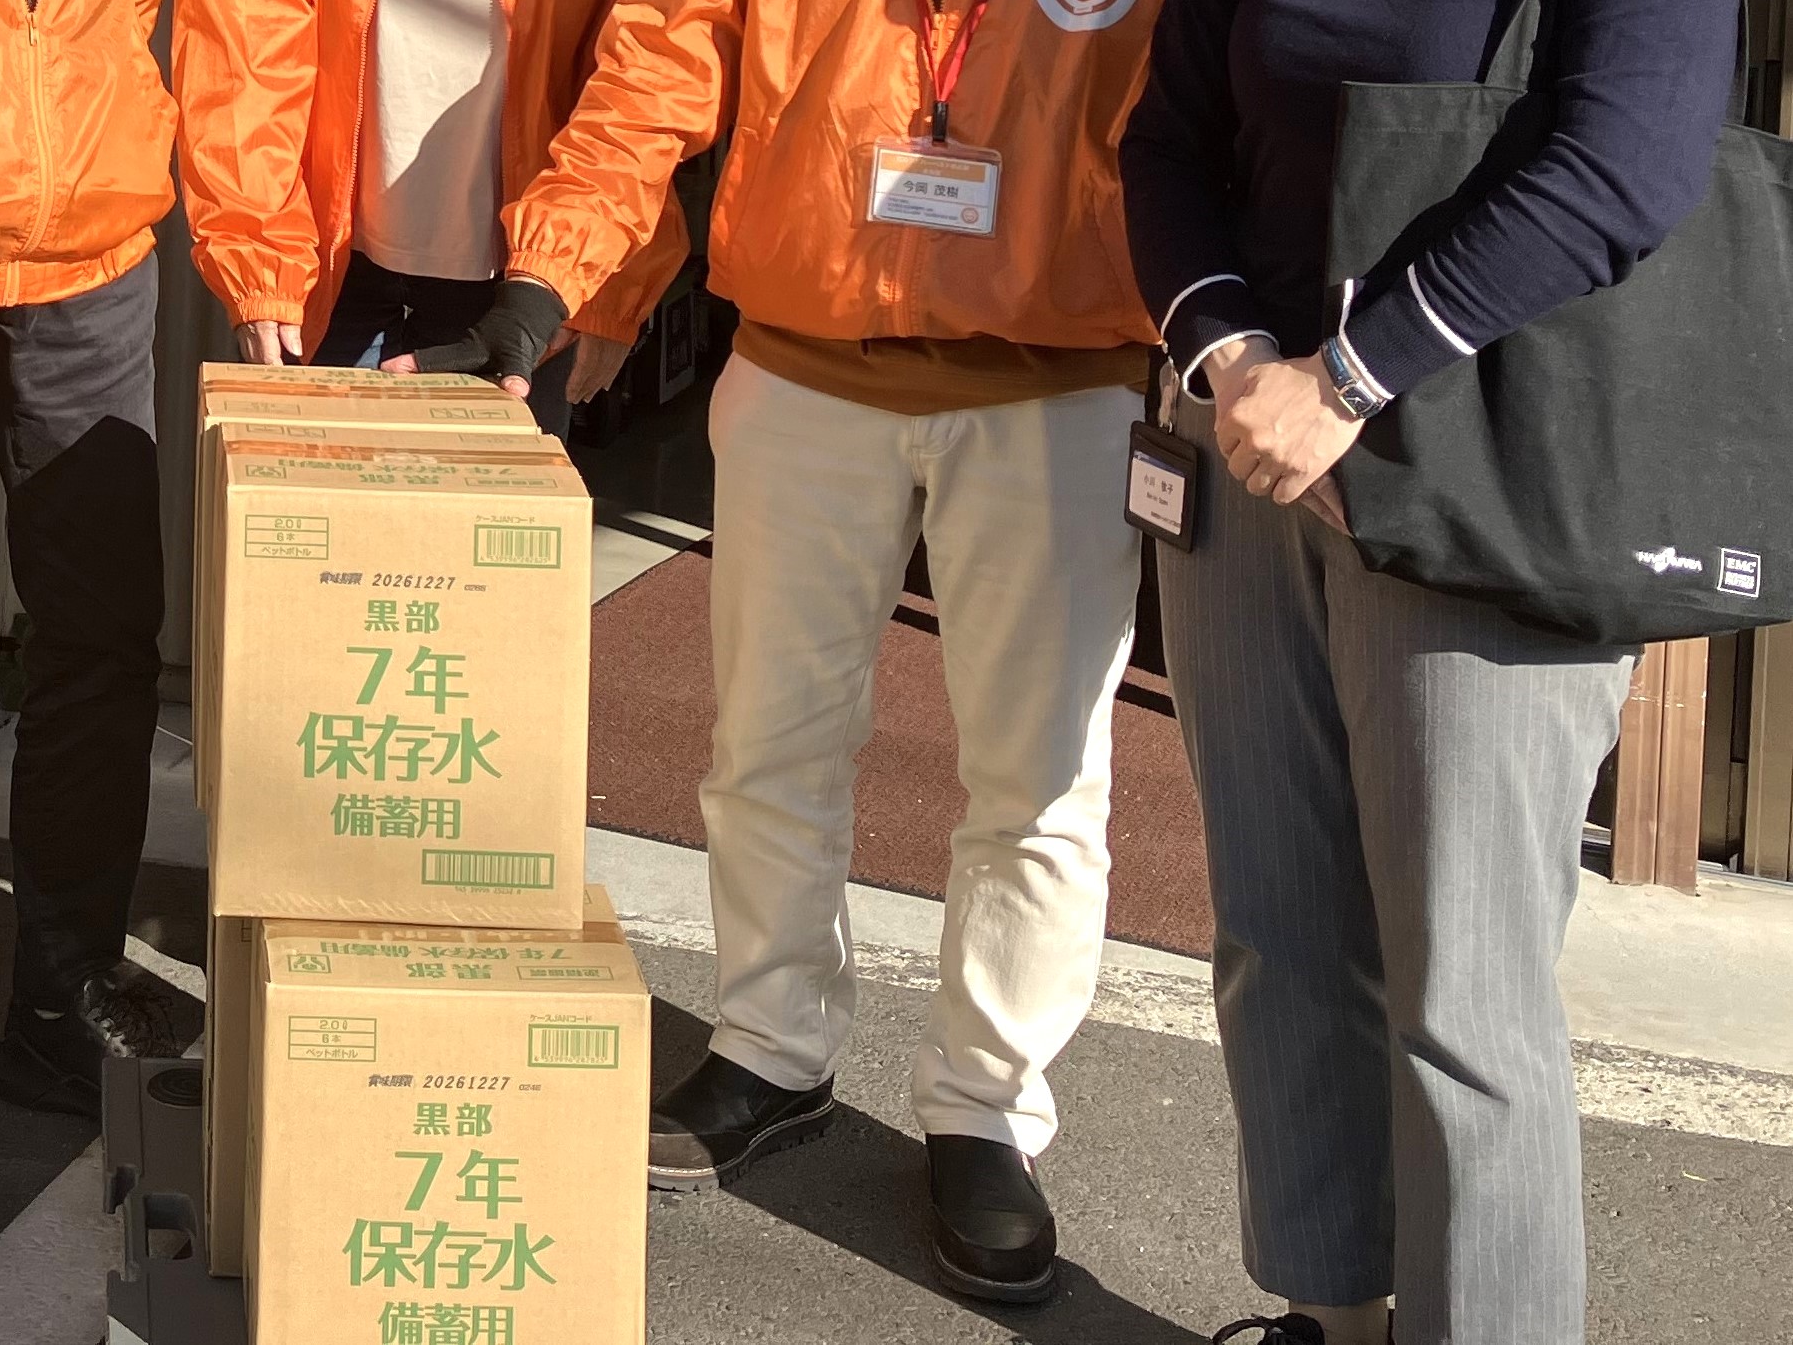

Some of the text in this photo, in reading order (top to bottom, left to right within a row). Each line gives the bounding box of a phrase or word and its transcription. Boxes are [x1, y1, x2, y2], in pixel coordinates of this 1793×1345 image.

[372, 573, 456, 590] 20261227
[1726, 558, 1757, 573] EMC
[364, 601, 440, 634] 黒部
[346, 645, 470, 715] 7年
[296, 712, 503, 783] 保存水
[330, 794, 461, 840] 備蓄用
[422, 1074, 511, 1090] 20261227
[412, 1102, 493, 1137] 黒部
[394, 1149, 523, 1220] 7年
[342, 1218, 557, 1292] 保存水
[377, 1301, 514, 1345] 備蓄用
